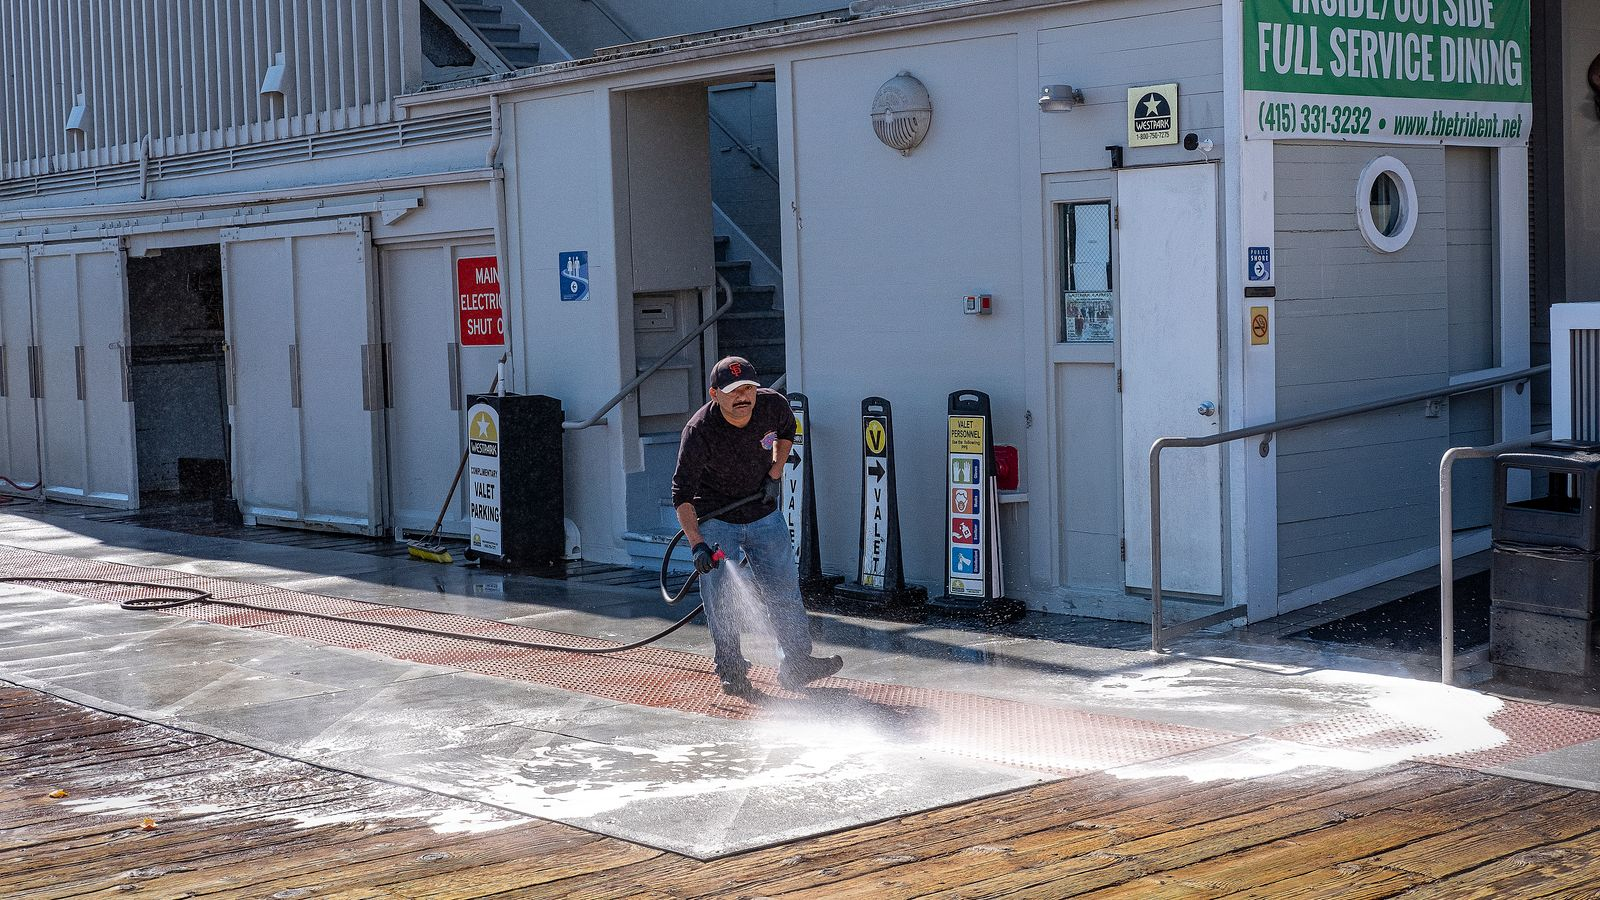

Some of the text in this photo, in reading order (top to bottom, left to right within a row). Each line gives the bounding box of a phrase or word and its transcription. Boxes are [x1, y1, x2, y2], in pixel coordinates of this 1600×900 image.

[1258, 22, 1522, 86] FULL SERVICE DINING
[1135, 119, 1170, 131] WESTPARK
[1258, 100, 1523, 138] (415) 331-3232 www.thetrident.net
[475, 267, 500, 284] MAIN
[467, 318, 493, 335] SHUT
[957, 420, 974, 429] VALET
[869, 430, 881, 451] V
[951, 429, 981, 439] PERSONNEL
[471, 442, 498, 455] WESTPARK
[474, 481, 495, 500] VALET
[471, 503, 500, 523] PARKING
[873, 488, 882, 573] VALET
